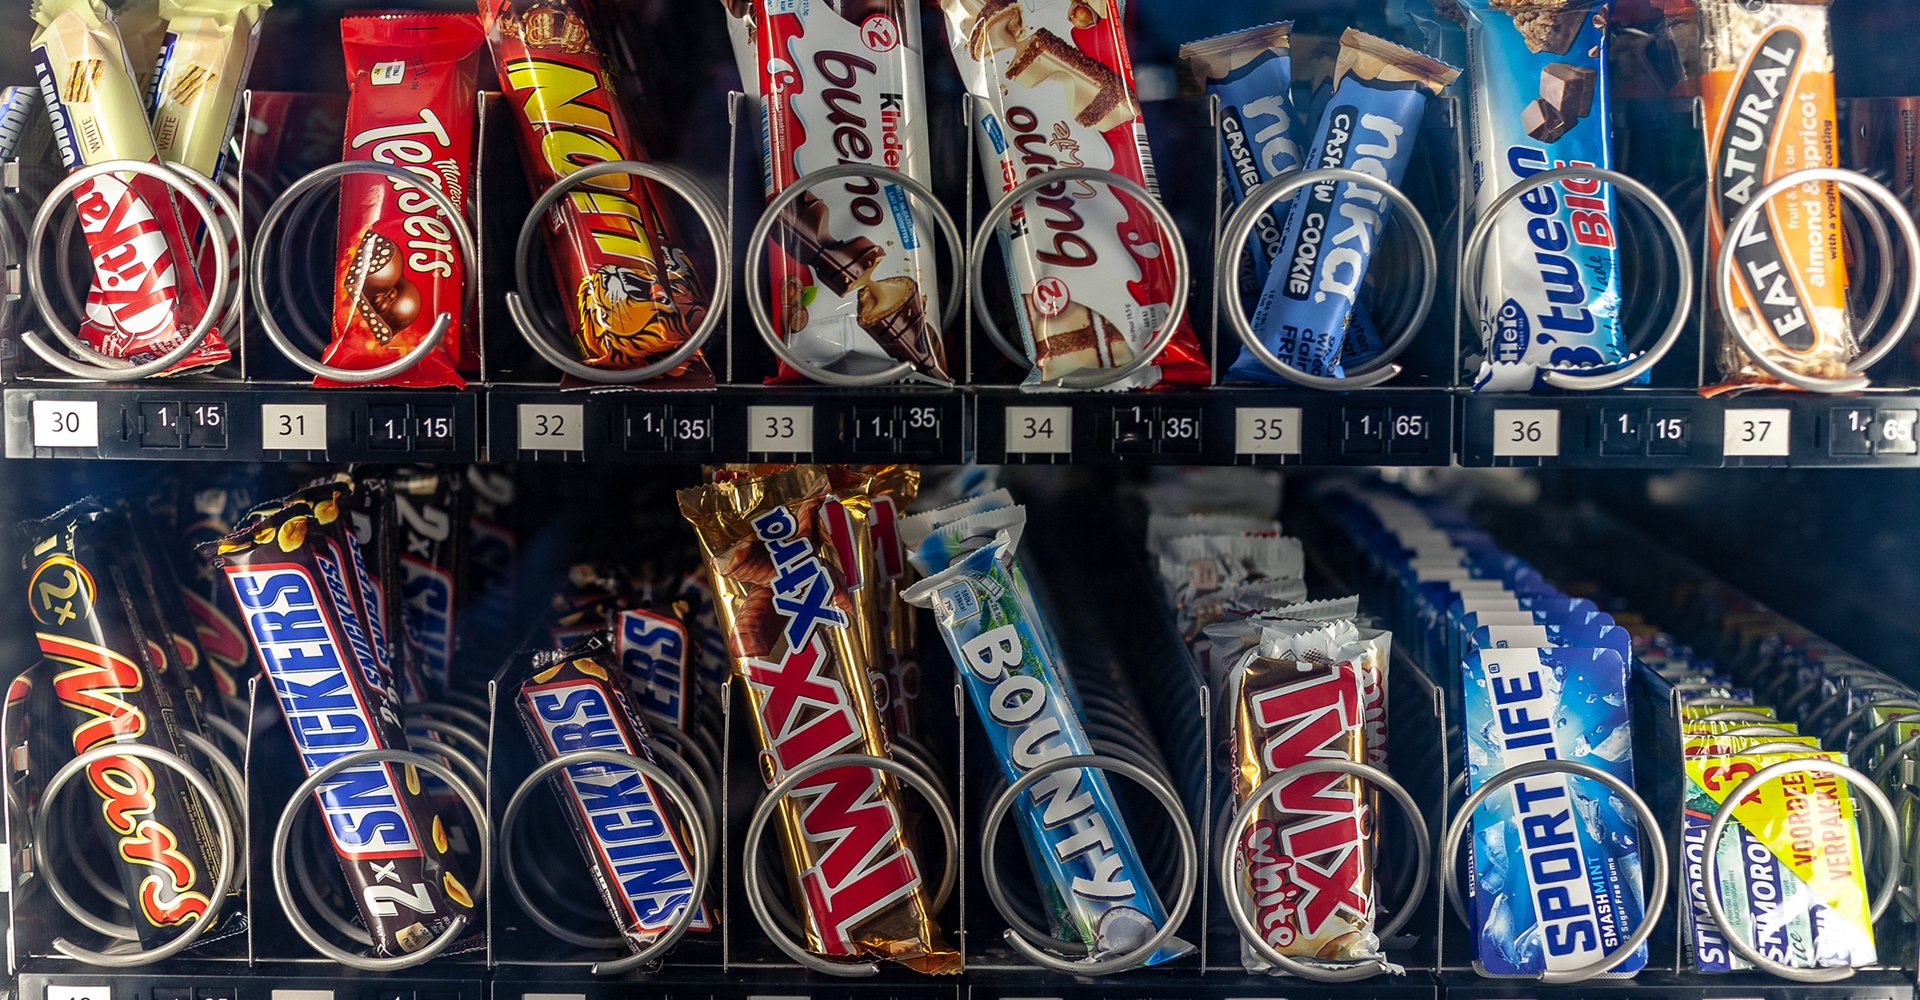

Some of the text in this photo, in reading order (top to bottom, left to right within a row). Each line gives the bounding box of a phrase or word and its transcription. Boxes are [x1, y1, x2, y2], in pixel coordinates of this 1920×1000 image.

[81, 115, 101, 154] WHITE
[158, 115, 177, 151] WHITE
[813, 50, 884, 227] bueno
[1784, 144, 1796, 164] bar
[1798, 92, 1823, 170] apricot
[431, 157, 463, 213] Maltese
[505, 57, 659, 271] LION
[1006, 106, 1098, 268] bueno
[351, 107, 456, 279] Teasers
[1289, 113, 1350, 295] CASHEW COOKIE
[1555, 160, 1617, 249] BIG
[1723, 45, 1807, 337] EAT NATURAL
[1785, 189, 1798, 201] &
[1821, 120, 1838, 261] with a yoghu coating
[1786, 204, 1799, 230] fruit
[1803, 200, 1826, 288] almond
[1274, 323, 1301, 365] FRE
[1293, 327, 1318, 373] dair
[1350, 312, 1369, 352] luten
[1500, 304, 1519, 363] Hero
[51, 411, 80, 433] 30
[158, 407, 220, 427] 1. 15
[278, 414, 305, 436] 31
[385, 419, 448, 439] 1. 15
[535, 414, 565, 437] 32
[643, 413, 705, 439] 1. 35
[765, 418, 794, 438] 33
[871, 409, 936, 437] 1. 35
[1023, 417, 1054, 438] 34
[1132, 406, 1193, 437] 1. 35
[1253, 419, 1283, 440] 35
[1360, 416, 1422, 436] 1. 65
[1511, 421, 1541, 442] 36
[1618, 415, 1682, 439] 1. 15
[1741, 421, 1771, 442] 37
[1849, 412, 1910, 440] 1. 65
[39, 569, 78, 626] 2x
[752, 506, 848, 652] Xtra
[317, 558, 386, 692] SNICKERS
[232, 573, 413, 848] SNICKERS
[35, 630, 215, 929] Mars
[961, 623, 1136, 902] BOUNTY
[1462, 731, 1471, 796] ASHMINT
[745, 632, 923, 956] TWIX
[1252, 660, 1368, 939] TWIX
[1781, 765, 1818, 868] VOORDEE
[363, 860, 437, 917] 2x
[1245, 820, 1297, 950] white
[1607, 856, 1619, 883] Gums
[1587, 855, 1618, 948] SMASHMINT
[1612, 883, 1623, 905] Free
[1685, 822, 1725, 965] STIMOROL
[1615, 906, 1630, 933] Sugar
